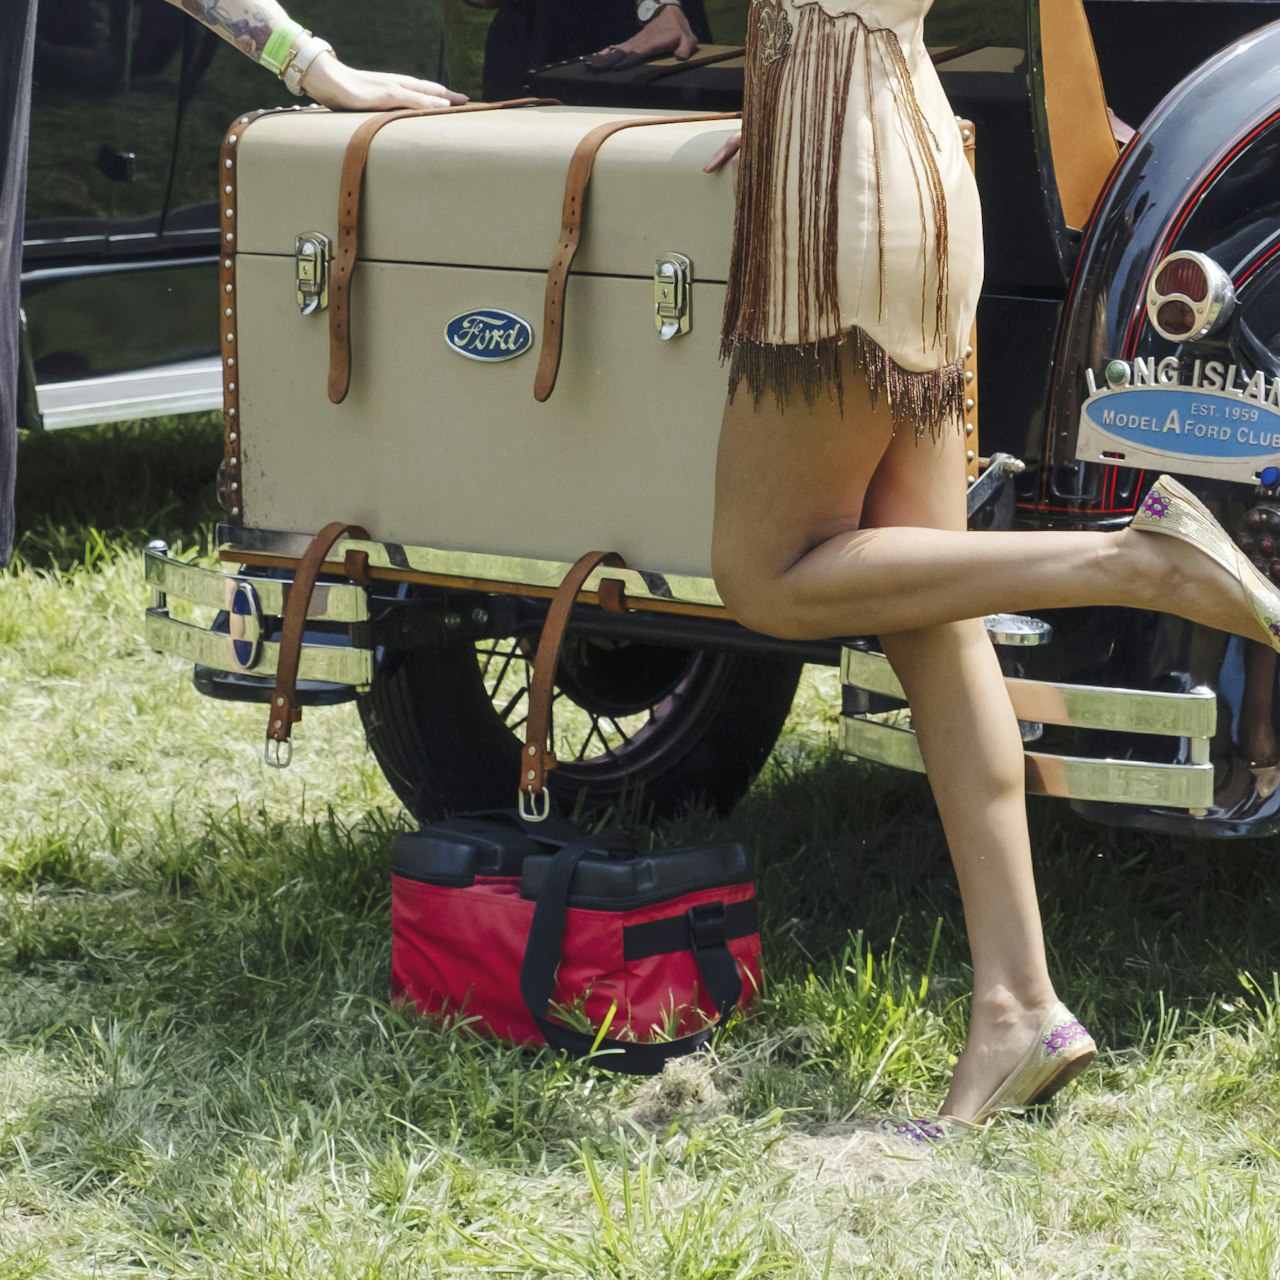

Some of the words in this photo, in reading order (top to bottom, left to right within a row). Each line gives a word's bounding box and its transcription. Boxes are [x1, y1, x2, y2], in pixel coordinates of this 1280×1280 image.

[454, 315, 524, 351] Ford
[1102, 409, 1160, 432] MODEL
[1163, 409, 1182, 435] A
[1184, 421, 1231, 442] FORD
[1191, 403, 1218, 417] EST.
[1224, 406, 1259, 423] 1959
